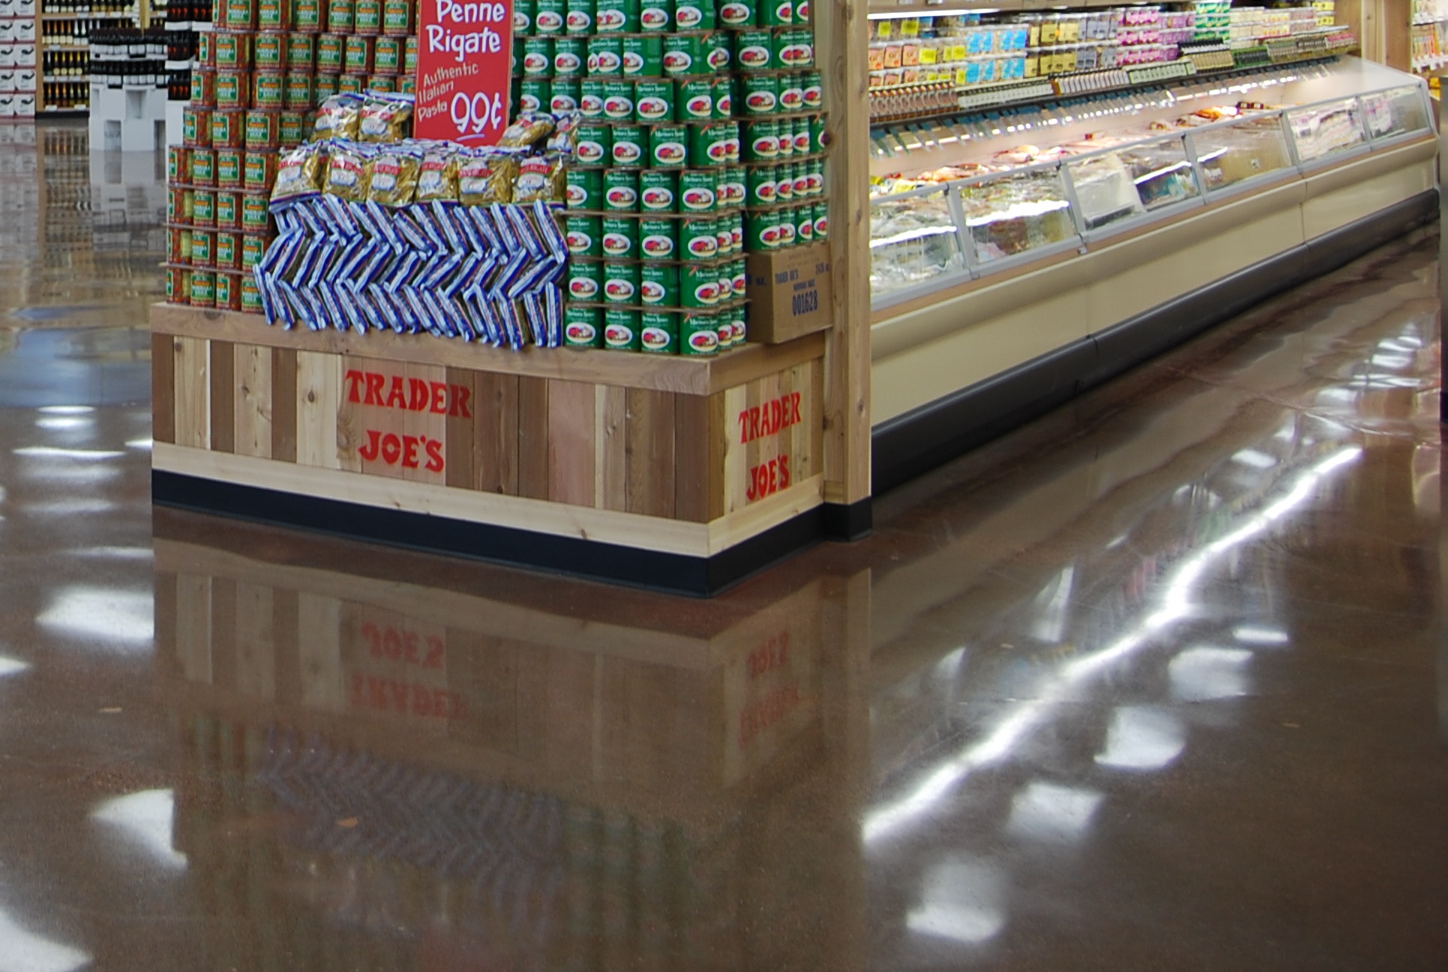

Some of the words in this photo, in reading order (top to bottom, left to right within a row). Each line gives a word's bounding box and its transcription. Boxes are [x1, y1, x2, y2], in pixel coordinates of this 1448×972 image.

[425, 24, 502, 63] Rigate
[418, 80, 455, 105] Italian
[423, 62, 480, 89] Authentic
[417, 100, 448, 123] Pasta
[450, 91, 503, 134] 99¢
[345, 369, 472, 419] TRADER
[737, 390, 802, 445] TRADER
[357, 428, 446, 473] JOE'S
[745, 452, 792, 501] JOE'S
